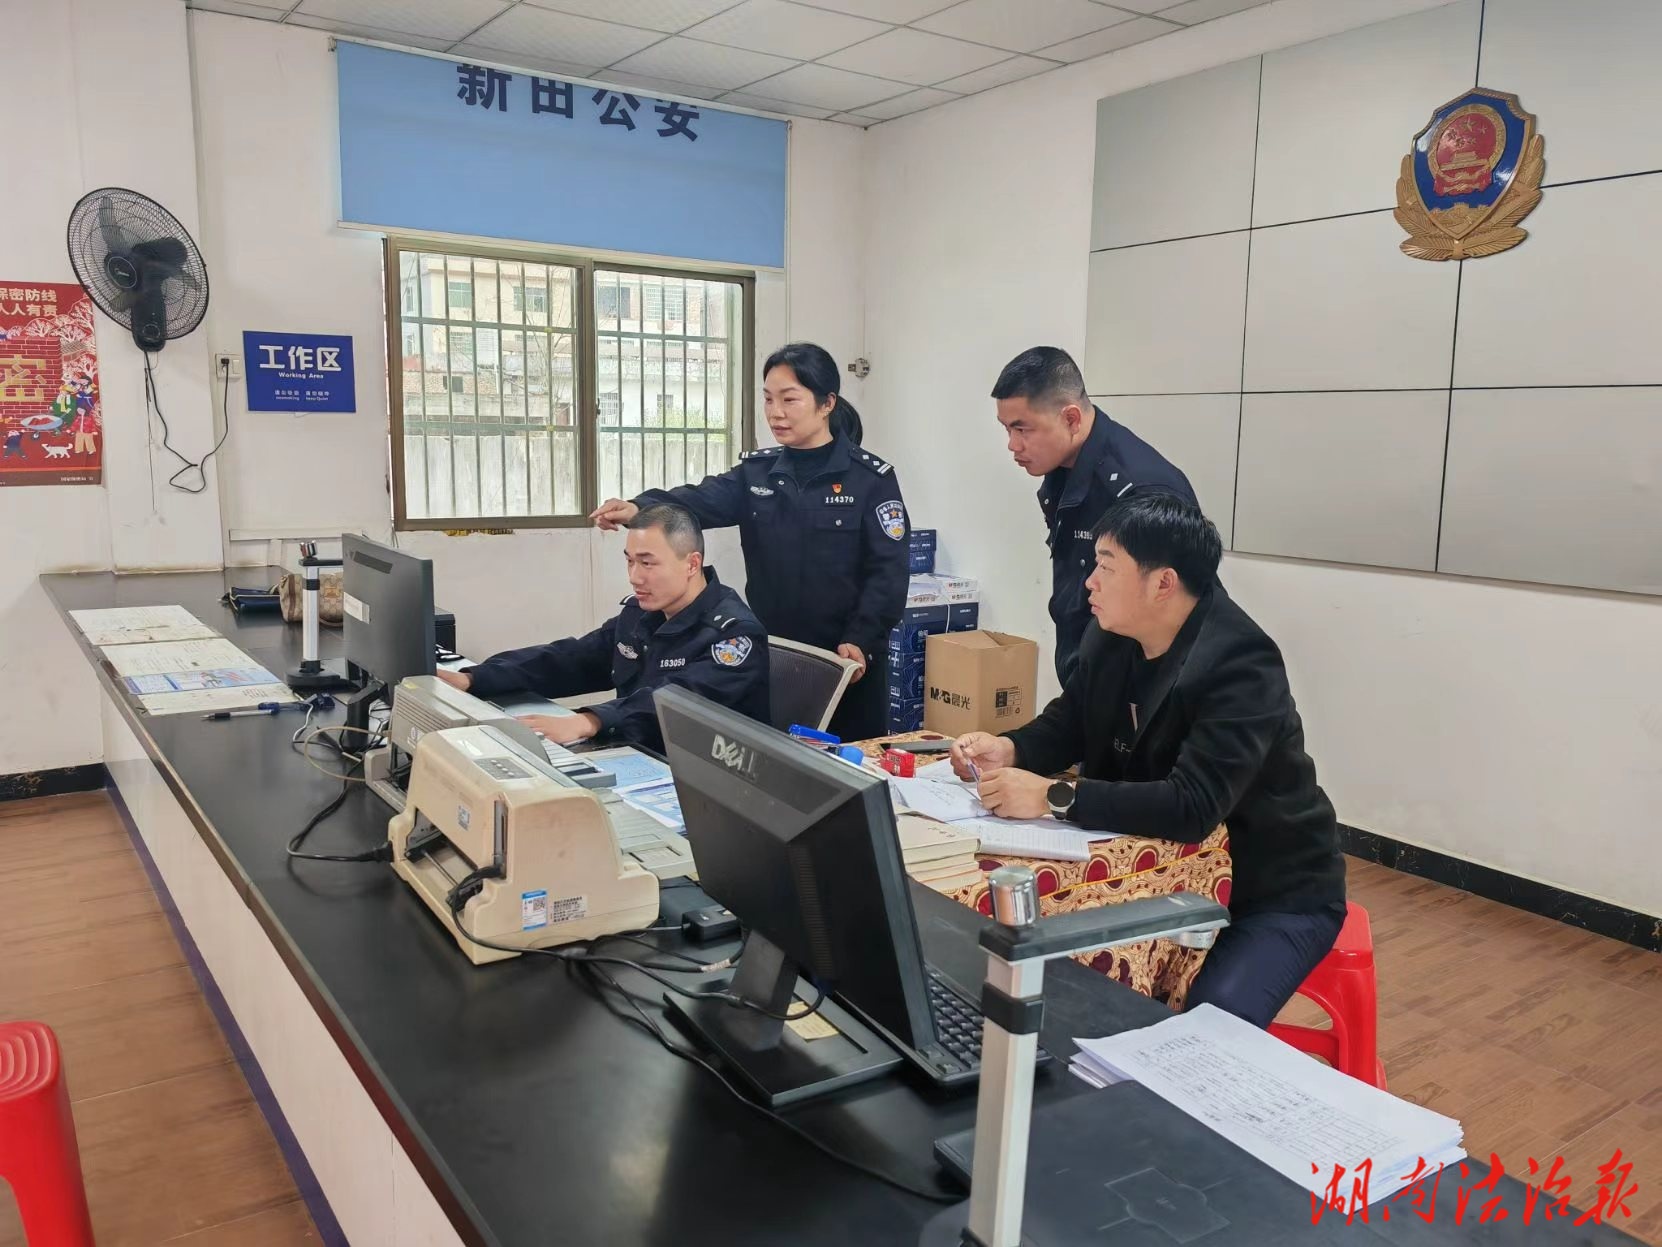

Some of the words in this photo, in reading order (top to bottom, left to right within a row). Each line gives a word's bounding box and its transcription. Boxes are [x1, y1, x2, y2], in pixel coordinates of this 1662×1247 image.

[258, 344, 342, 372] 工作区
[278, 372, 306, 380] Working
[825, 496, 854, 504] 114370
[660, 658, 686, 668] 163050
